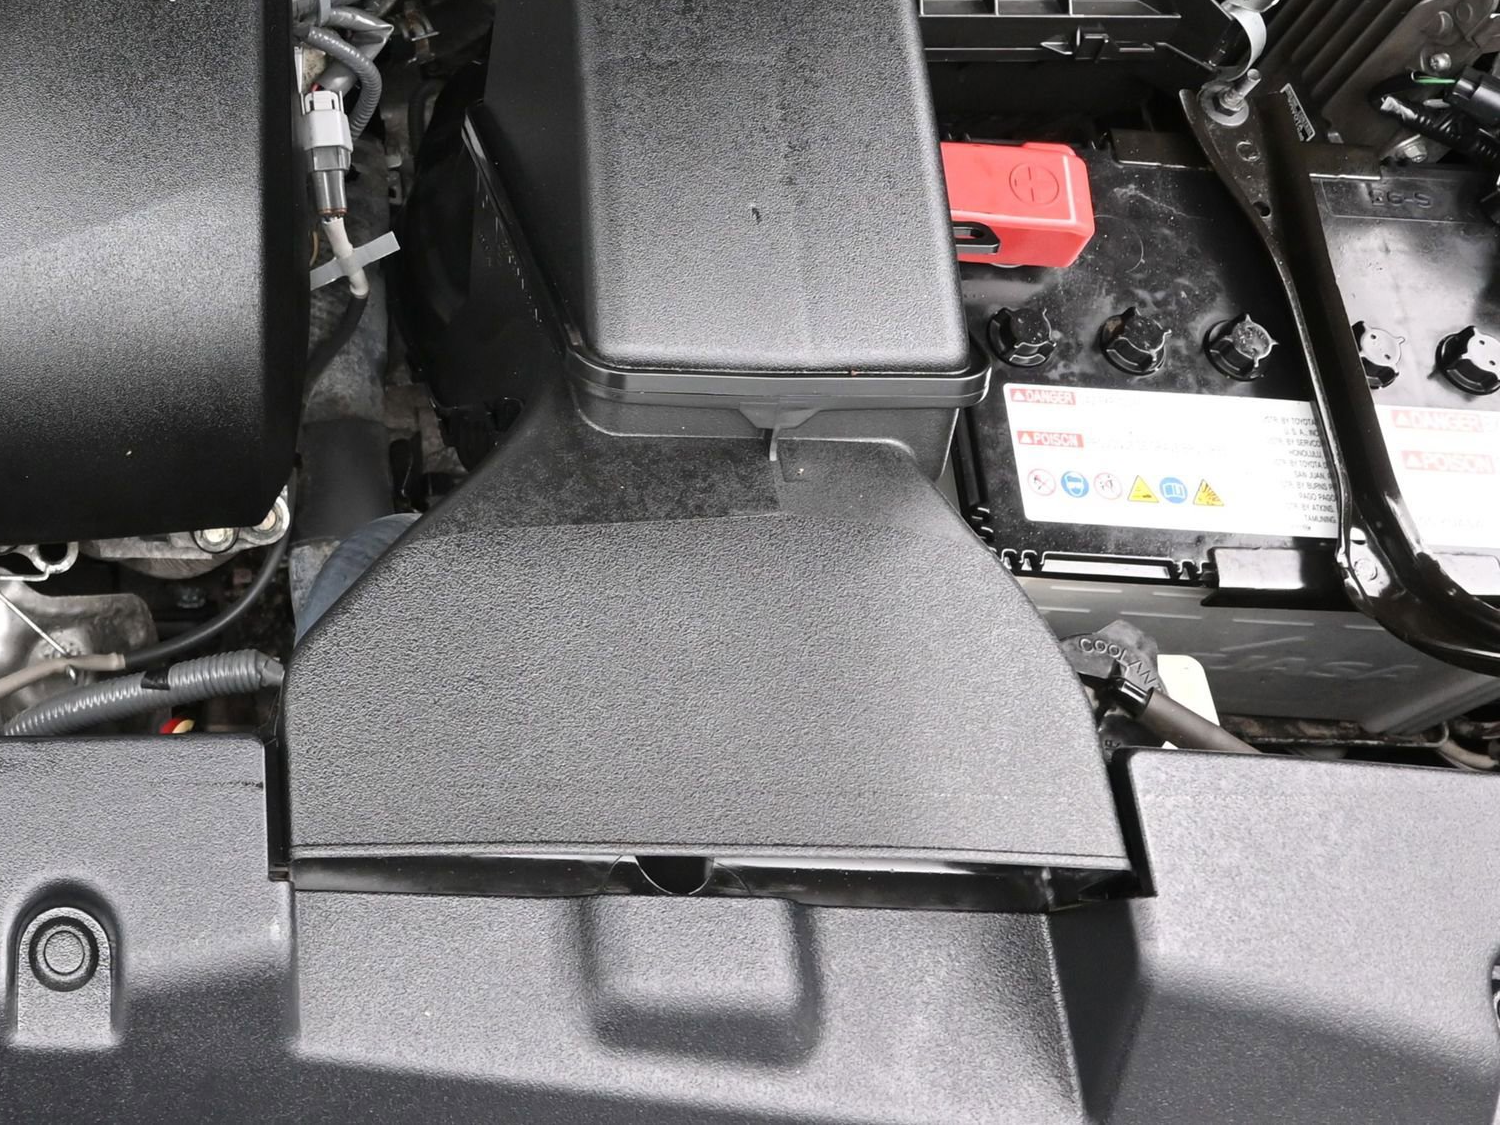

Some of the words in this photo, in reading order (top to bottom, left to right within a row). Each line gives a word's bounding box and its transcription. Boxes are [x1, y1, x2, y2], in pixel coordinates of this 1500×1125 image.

[1027, 389, 1074, 405] DANGER
[1411, 411, 1479, 431] DANGER
[1034, 431, 1077, 447] POISON
[1425, 452, 1488, 473] POISON
[1079, 638, 1161, 693] COOLAN
